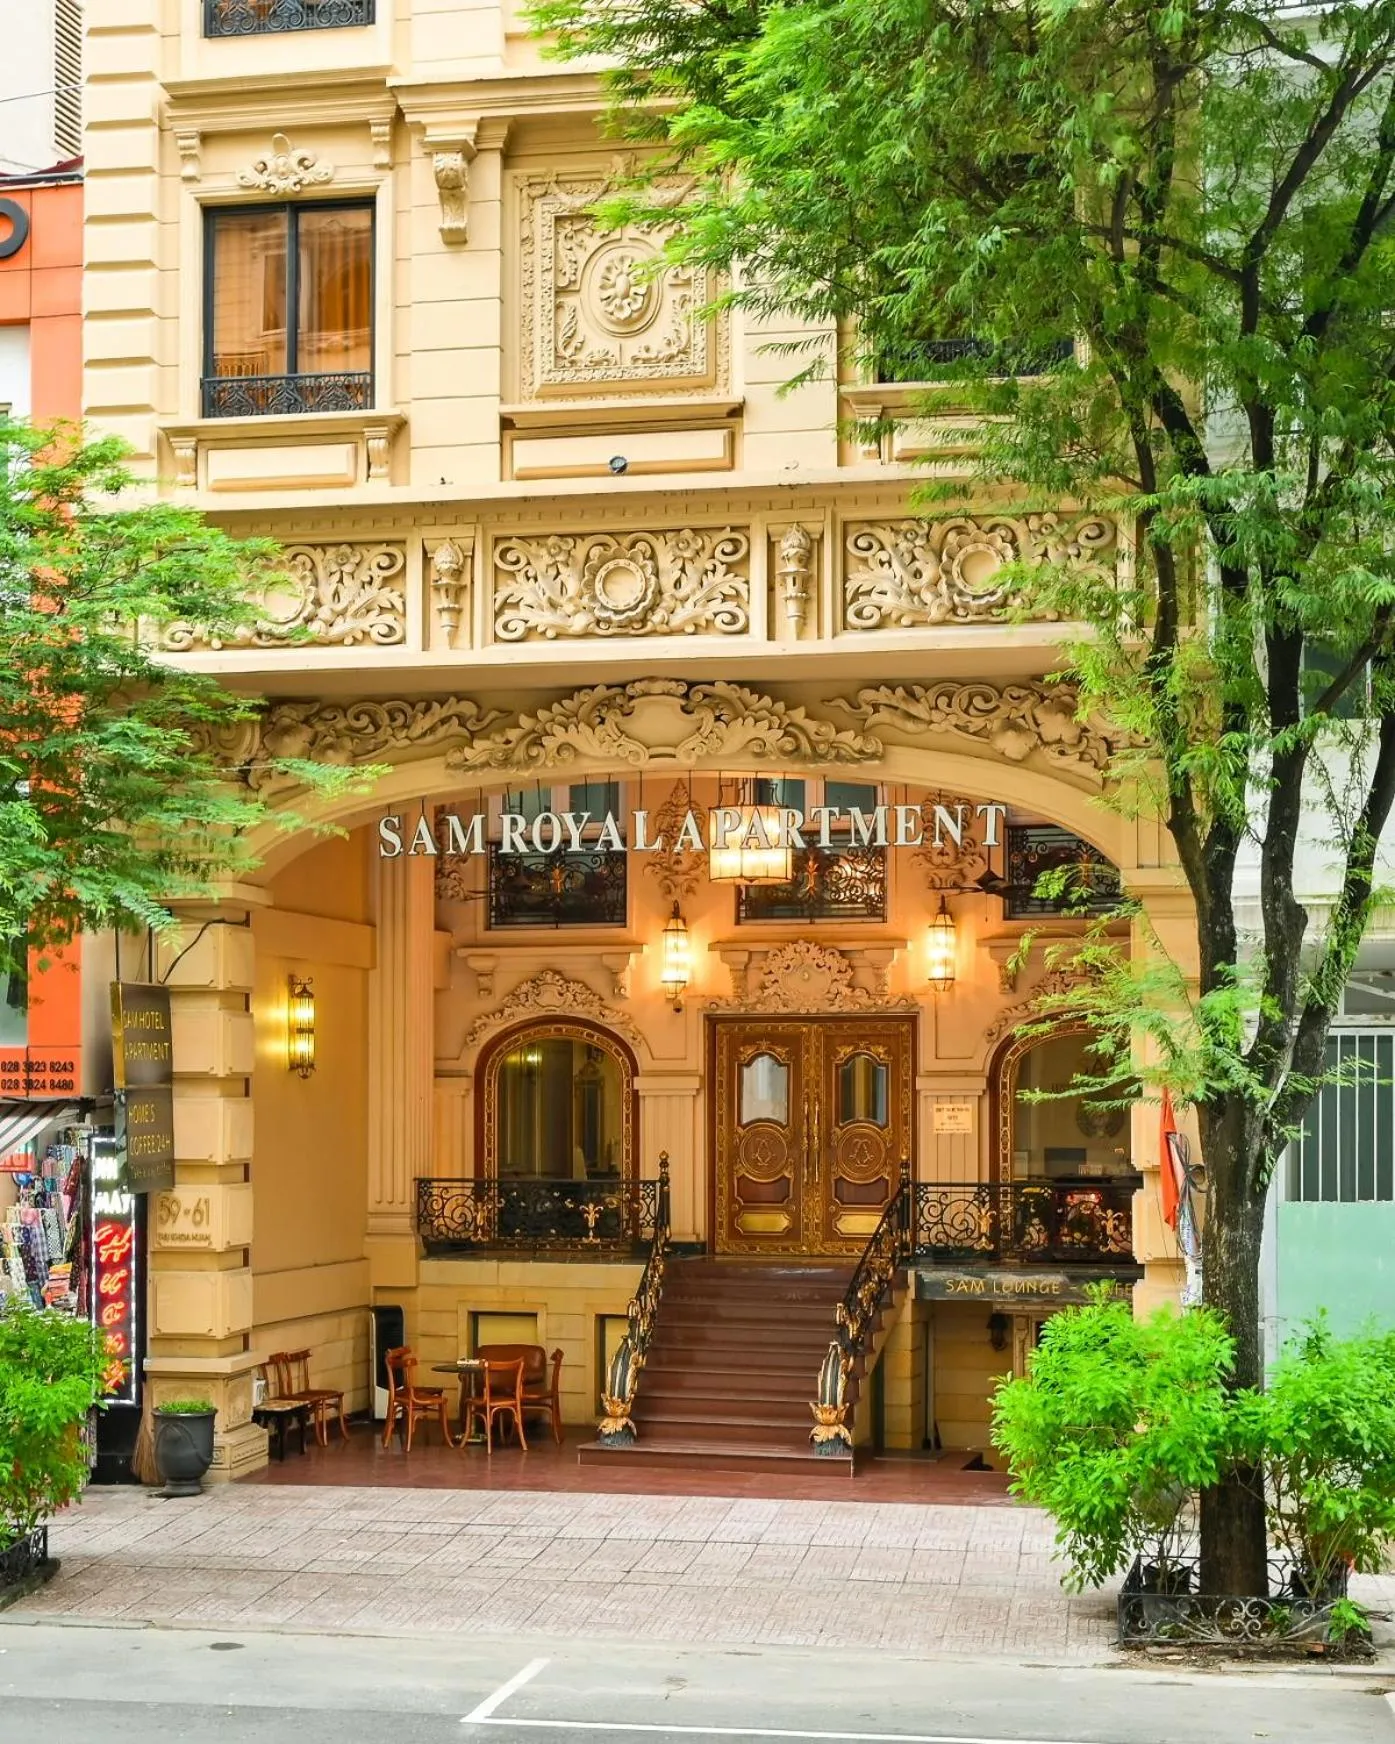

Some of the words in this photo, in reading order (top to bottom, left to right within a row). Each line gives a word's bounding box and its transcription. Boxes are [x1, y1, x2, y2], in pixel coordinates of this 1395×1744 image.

[378, 813, 486, 857] SAM
[499, 810, 664, 853] ROYAL
[673, 804, 1006, 851] APARTMENT
[139, 1010, 165, 1030] HOTEL
[125, 1042, 169, 1060] APARTMENT
[0, 1061, 19, 1073] 028
[22, 1061, 47, 1073] 3823
[49, 1061, 75, 1073] 8243
[0, 1079, 19, 1090] 028
[22, 1079, 47, 1090] 3824
[946, 1279, 985, 1294] SAM
[993, 1279, 1061, 1295] LOUNGE
